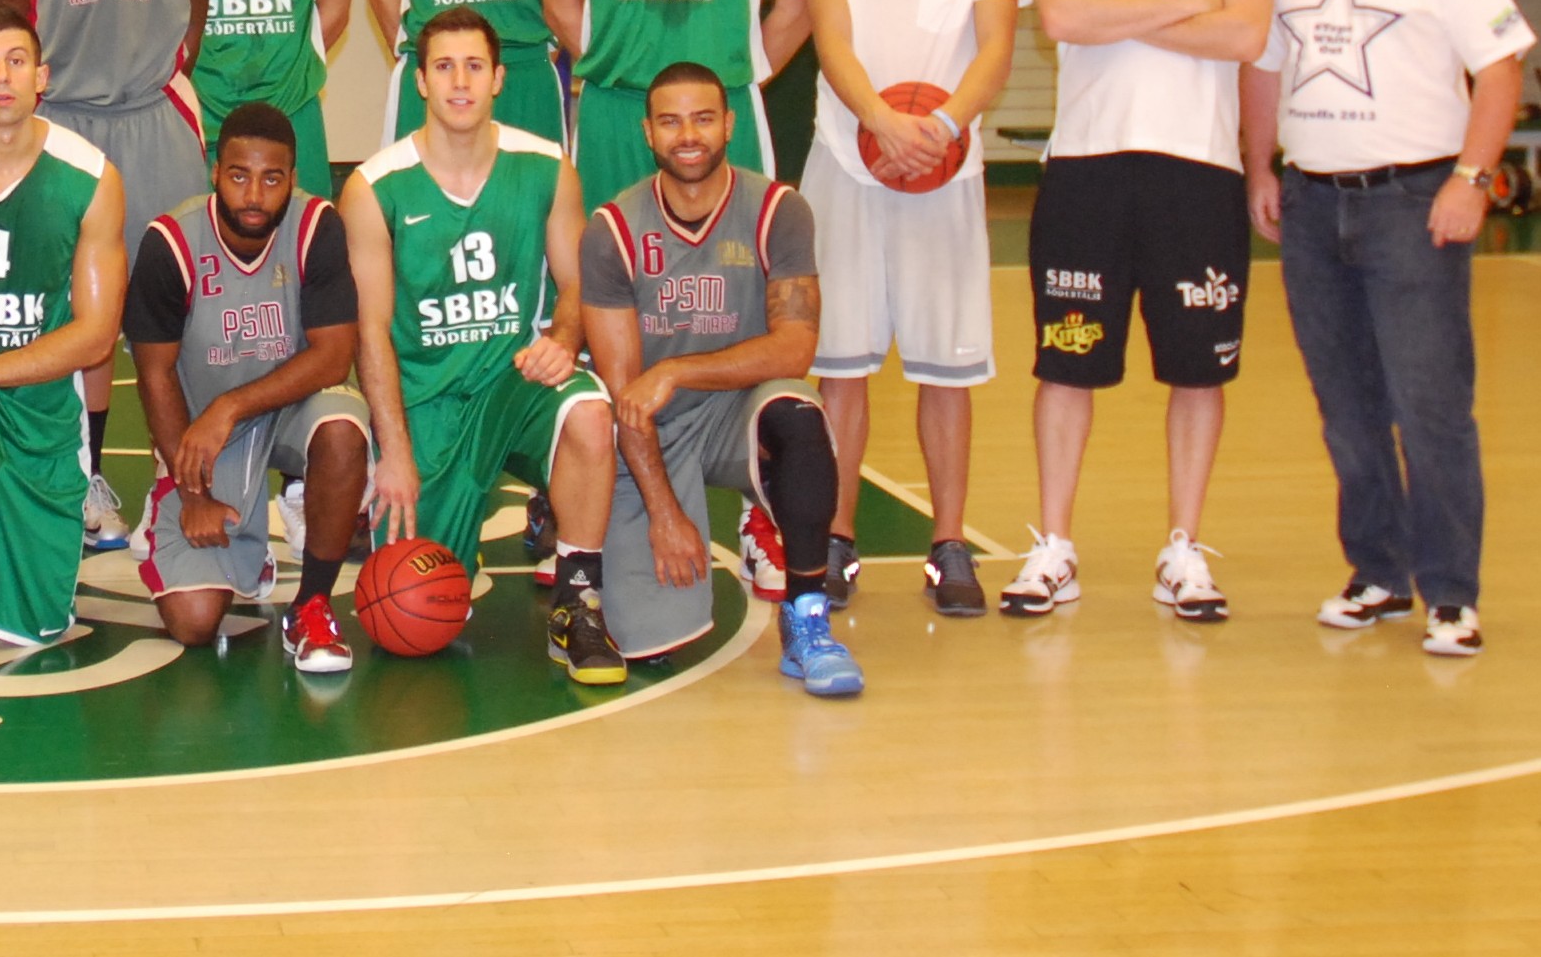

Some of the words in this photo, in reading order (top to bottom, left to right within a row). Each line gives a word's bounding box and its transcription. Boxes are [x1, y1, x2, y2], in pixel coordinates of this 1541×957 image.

[205, 18, 296, 36] SÖDERTÄLJE
[449, 231, 496, 284] 13
[641, 230, 666, 278] 6
[199, 253, 224, 299] 2
[658, 274, 725, 313] PSM
[1046, 267, 1103, 291] SBBK
[1176, 272, 1240, 311] Telge
[222, 301, 286, 344] PSM
[417, 282, 519, 329] SBBK
[420, 318, 521, 348] SÖDERTLJE
[1041, 320, 1105, 354] Kings
